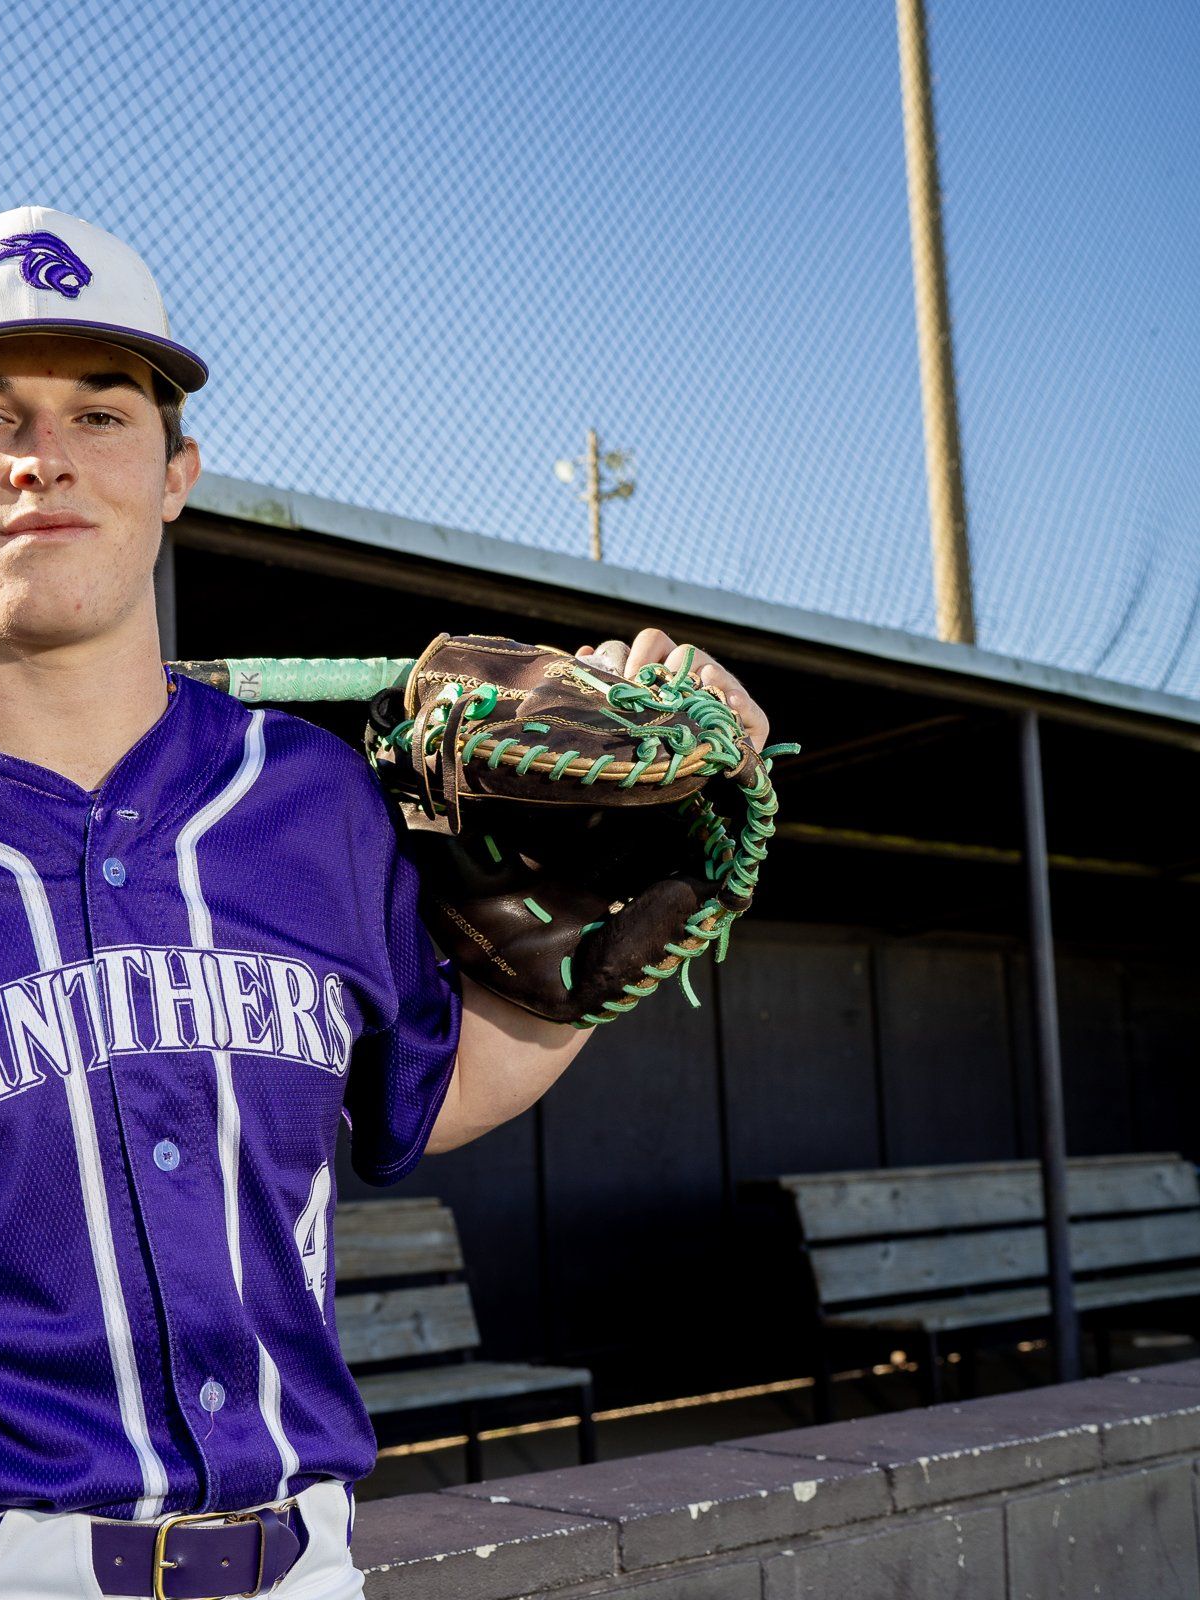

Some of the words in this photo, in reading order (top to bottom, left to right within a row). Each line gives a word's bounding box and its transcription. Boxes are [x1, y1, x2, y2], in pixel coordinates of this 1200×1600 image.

[238, 672, 259, 698] JK
[490, 954, 517, 976] player
[294, 1157, 332, 1326] 4
